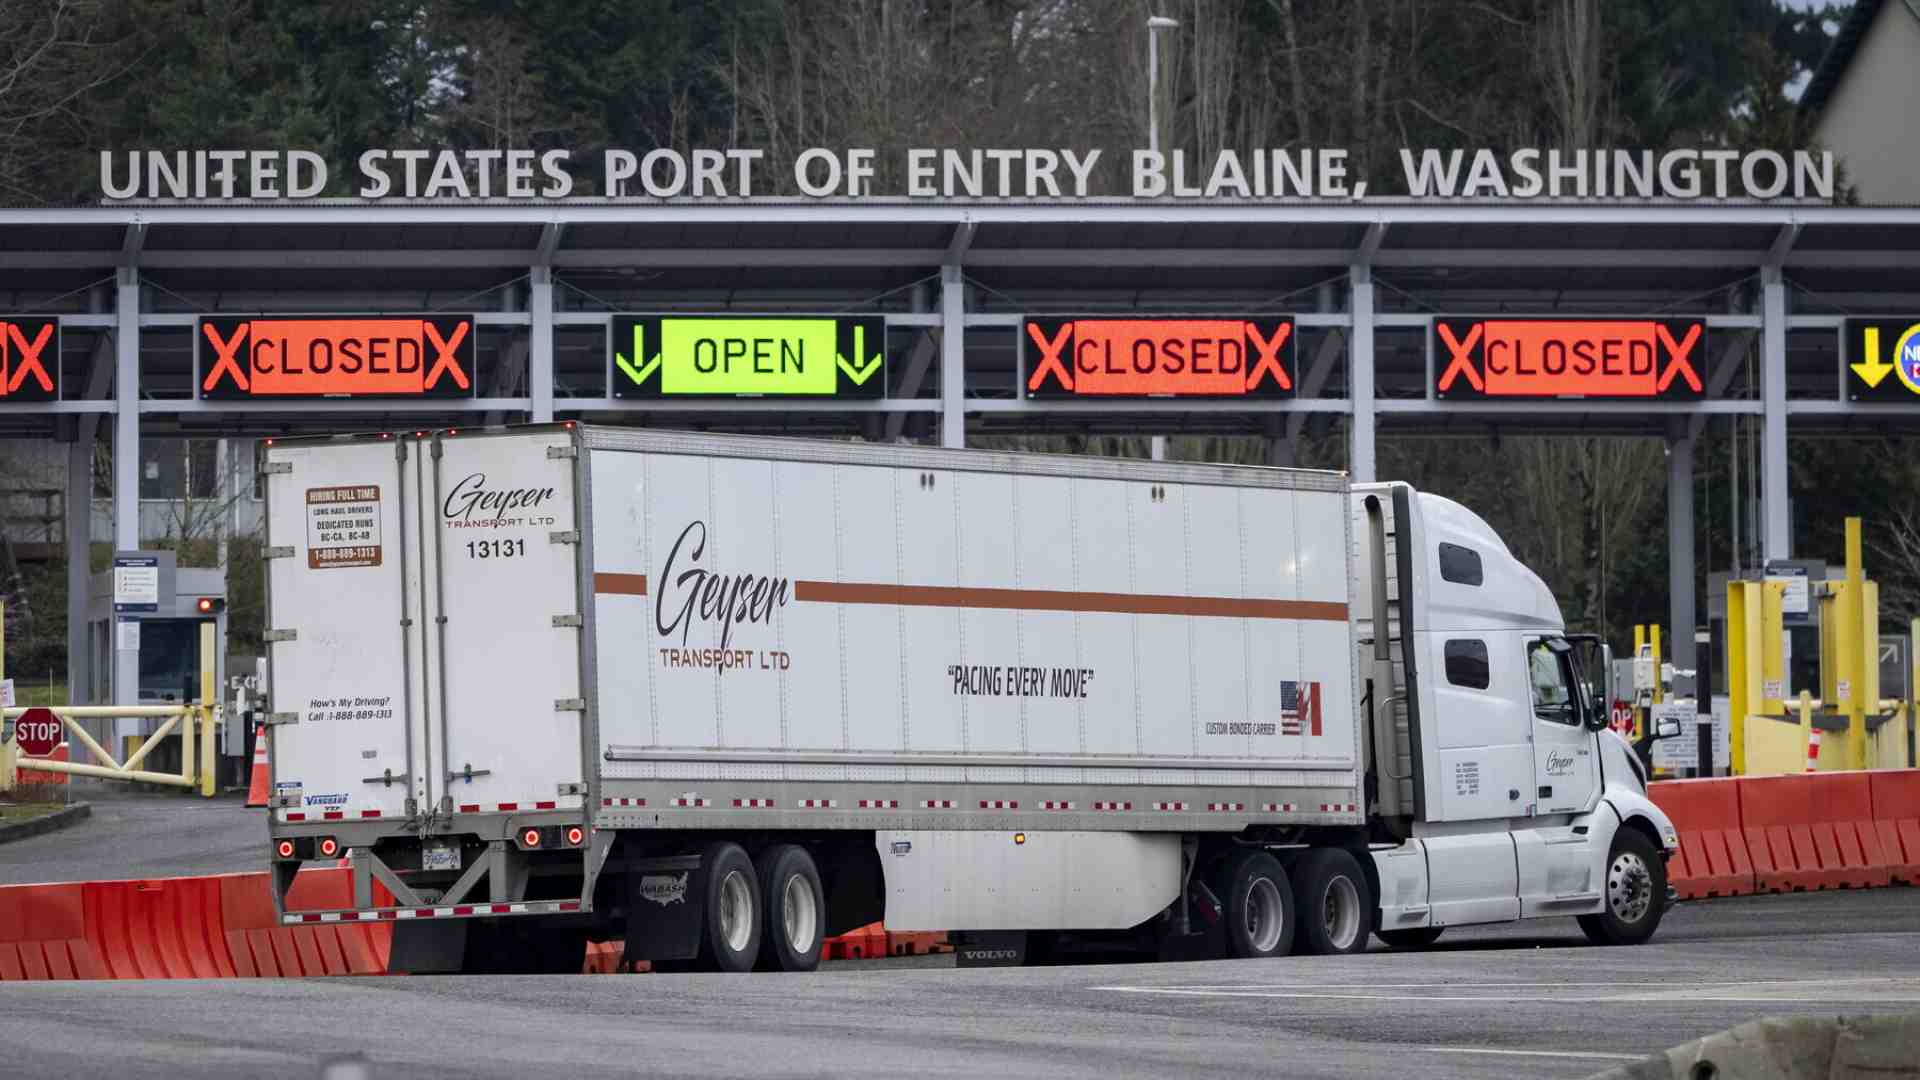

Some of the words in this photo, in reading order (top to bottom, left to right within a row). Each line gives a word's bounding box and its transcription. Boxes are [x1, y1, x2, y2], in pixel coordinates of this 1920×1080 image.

[100, 150, 328, 199] UNITED
[359, 149, 574, 199] STATES
[604, 148, 763, 198] PORT
[794, 147, 875, 198] OF
[908, 148, 1102, 198] ENTRY
[1132, 148, 1367, 201] BLAINE,
[1401, 149, 1834, 199] WASHINGTON
[252, 337, 420, 375] CLOSED
[693, 337, 804, 374] OPEN
[1076, 338, 1242, 375] CLOSED
[1487, 339, 1653, 376] CLOSED
[444, 473, 554, 521] Geyser
[316, 520, 354, 530] DEDICATED
[446, 519, 523, 529] TRANSPORT
[529, 517, 554, 526] LTD
[467, 539, 524, 558] 13131
[656, 520, 788, 676] Geyser
[660, 649, 753, 668] TRANSPORT
[760, 651, 790, 670] LTD
[1006, 667, 1047, 697] EVERY
[339, 698, 352, 709] My
[355, 696, 391, 707] Driving?
[308, 711, 324, 721] Call
[17, 722, 60, 741] STOP
[964, 950, 1017, 960] VOLVO
